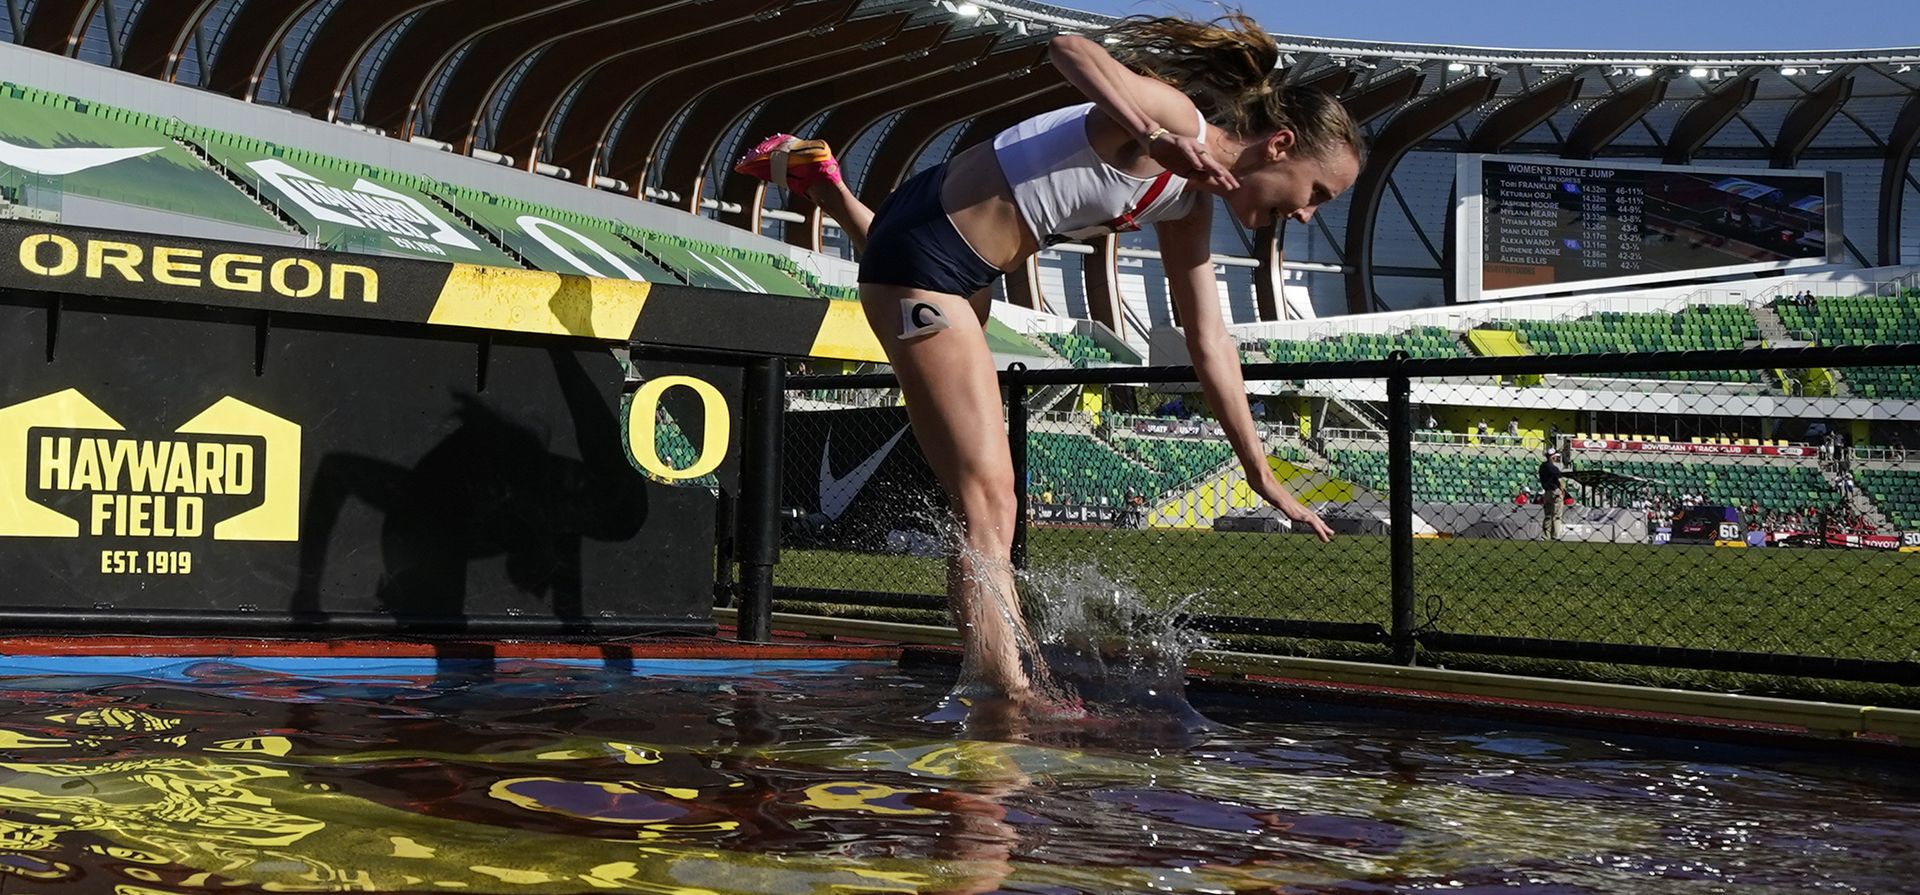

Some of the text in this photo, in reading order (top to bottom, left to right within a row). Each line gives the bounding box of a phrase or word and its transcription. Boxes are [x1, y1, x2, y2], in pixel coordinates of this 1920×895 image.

[1508, 164, 1615, 178] WOMEN'S TRIPLE JUMP
[1518, 181, 1556, 190] FRANKLIN
[286, 178, 428, 225] HAYWARD
[1530, 201, 1559, 209] MOORE
[1529, 219, 1557, 227] MARSH
[1530, 210, 1557, 218] HEARN
[349, 209, 430, 240] FIELD
[19, 233, 379, 303] OREGON
[628, 375, 730, 479] O
[40, 436, 253, 495] HAYWARD
[91, 494, 203, 537] FIELD
[1720, 524, 1739, 538] 60
[1904, 532, 1920, 545] 50
[102, 551, 192, 574] EST. 1919
